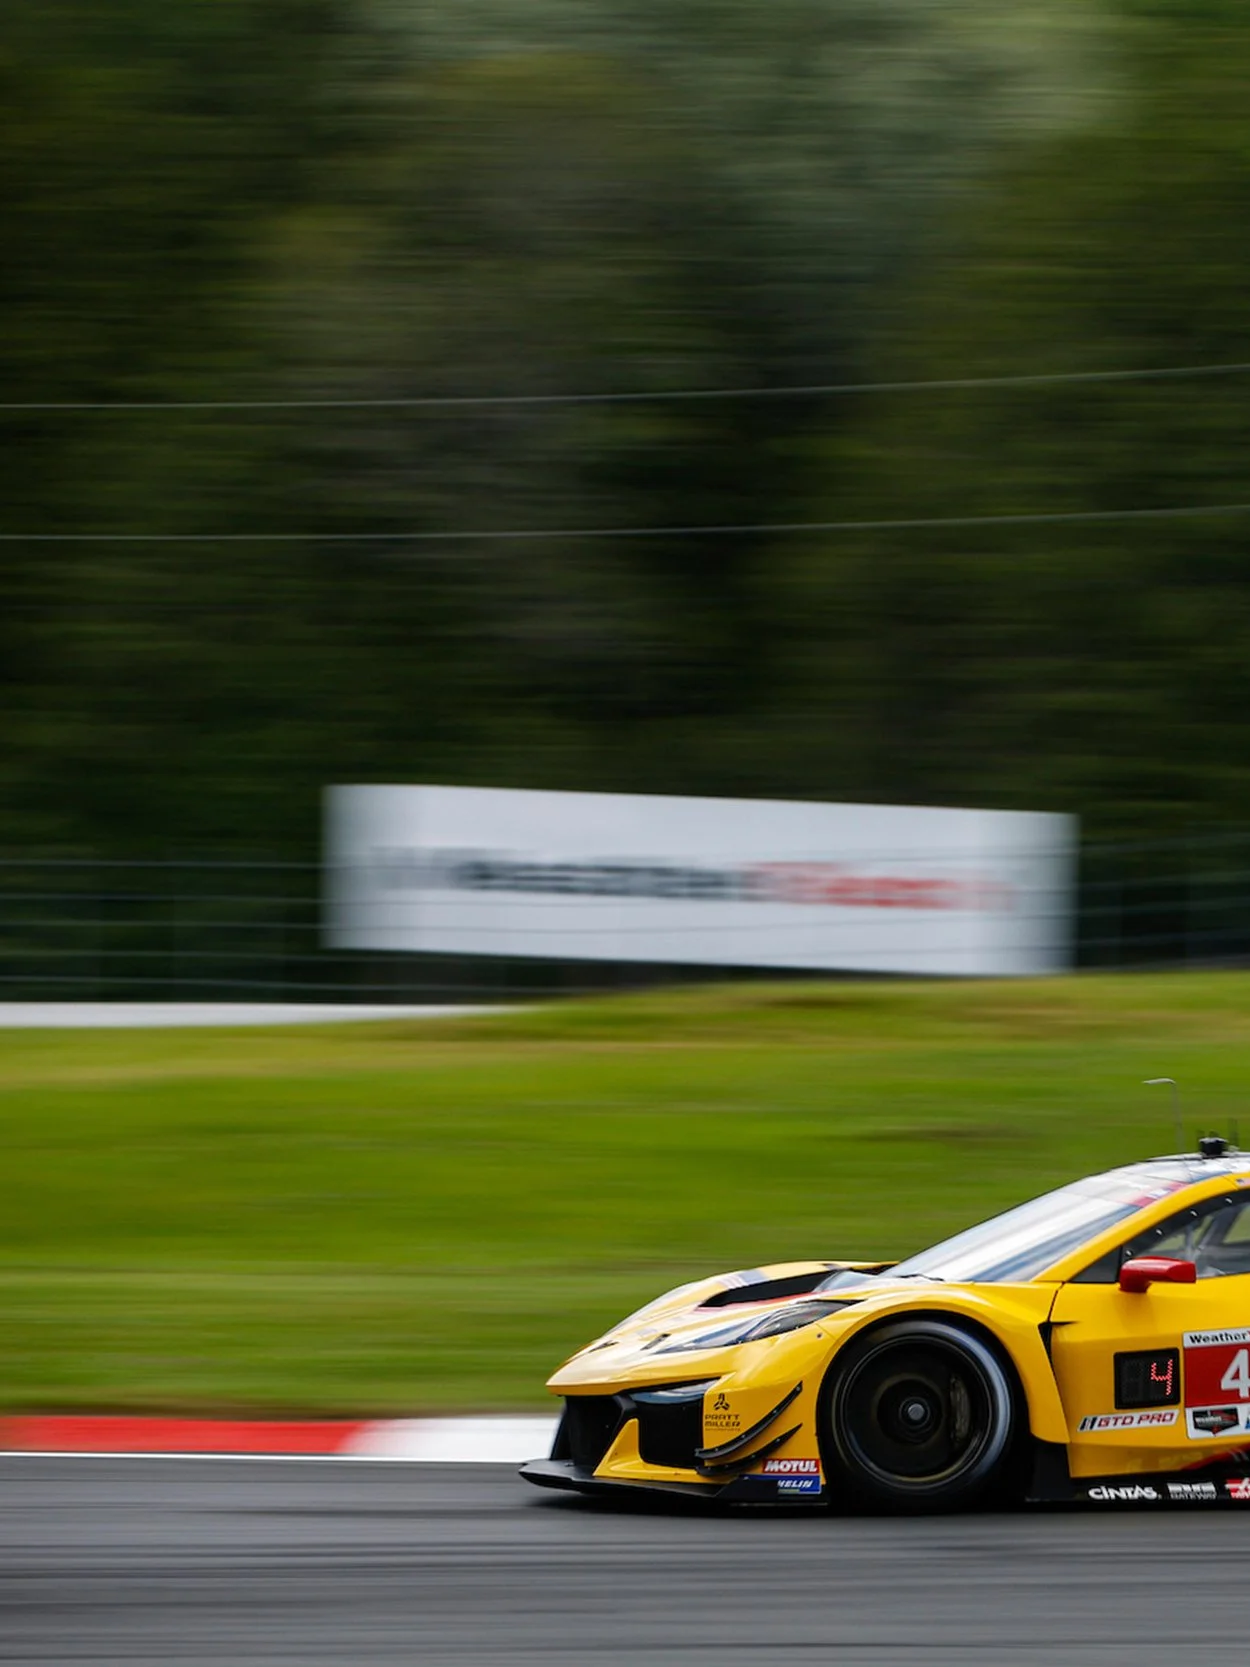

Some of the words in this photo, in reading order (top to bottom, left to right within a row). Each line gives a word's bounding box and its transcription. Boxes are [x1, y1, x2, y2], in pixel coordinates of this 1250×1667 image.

[1150, 1358, 1174, 1396] 4
[1097, 1414, 1135, 1428] GTD
[1137, 1411, 1175, 1425] PRO
[764, 1460, 818, 1472] MOTUL
